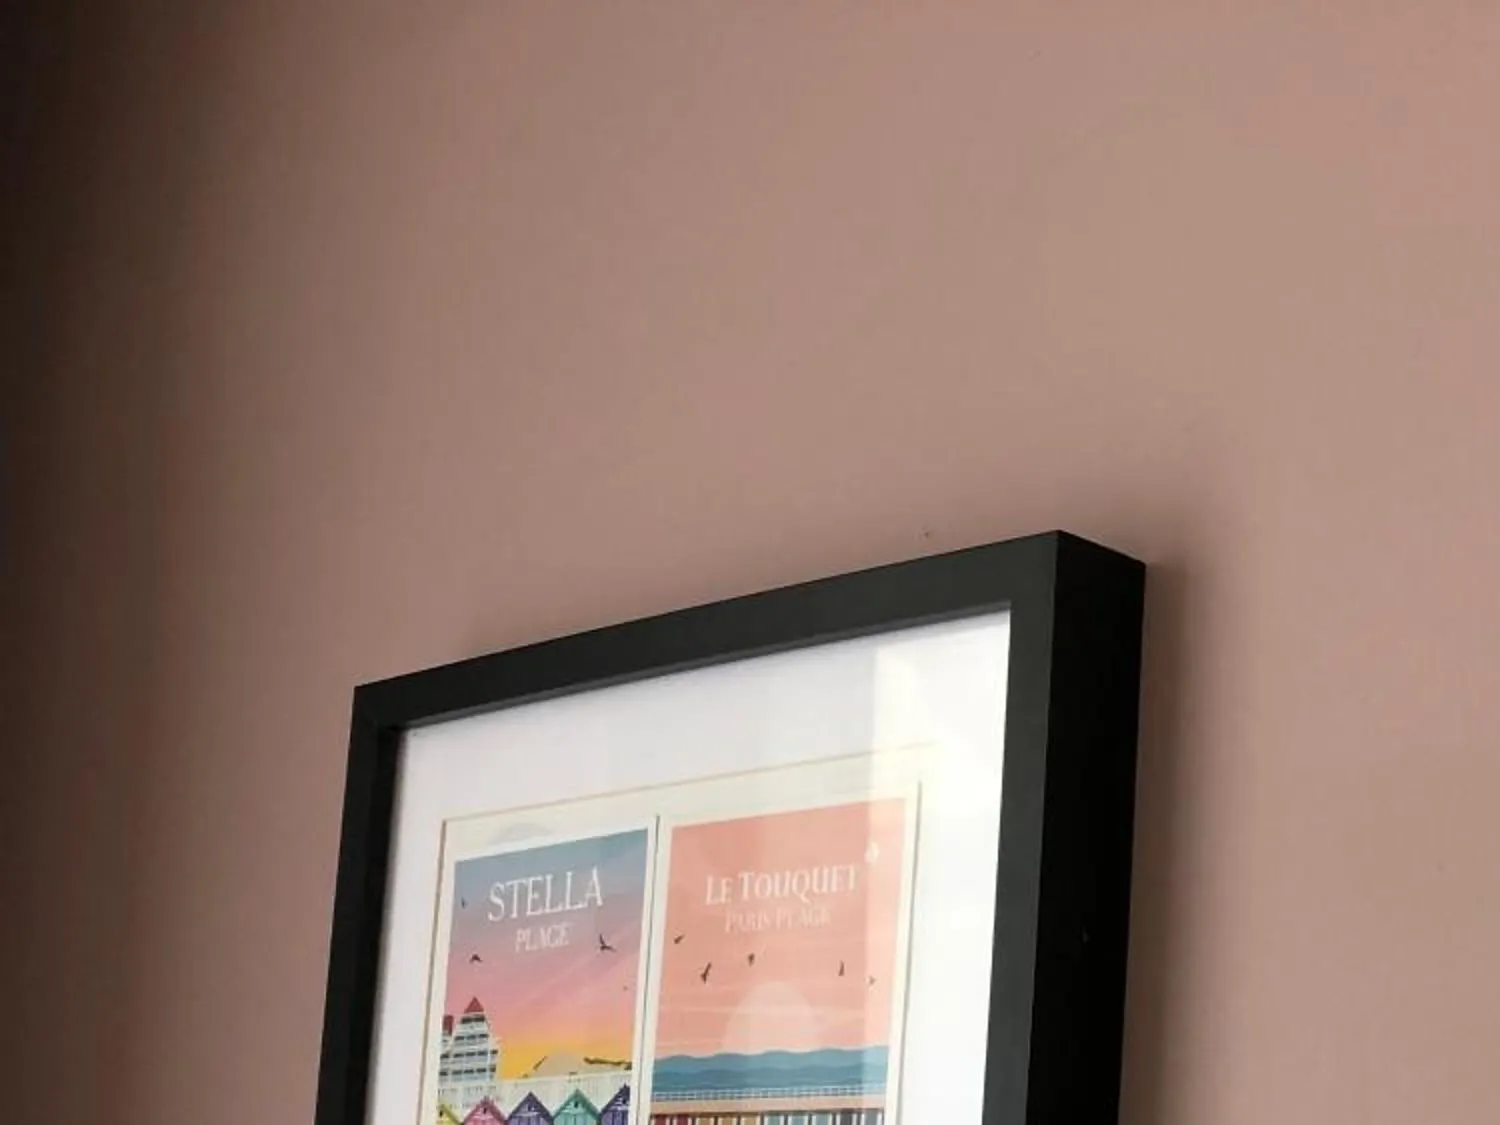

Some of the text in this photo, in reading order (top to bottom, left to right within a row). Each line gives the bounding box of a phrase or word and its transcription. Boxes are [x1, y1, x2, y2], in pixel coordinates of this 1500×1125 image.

[488, 867, 603, 922] STELLA
[705, 865, 858, 906] LE TOUQUET
[515, 924, 571, 952] PLAGE
